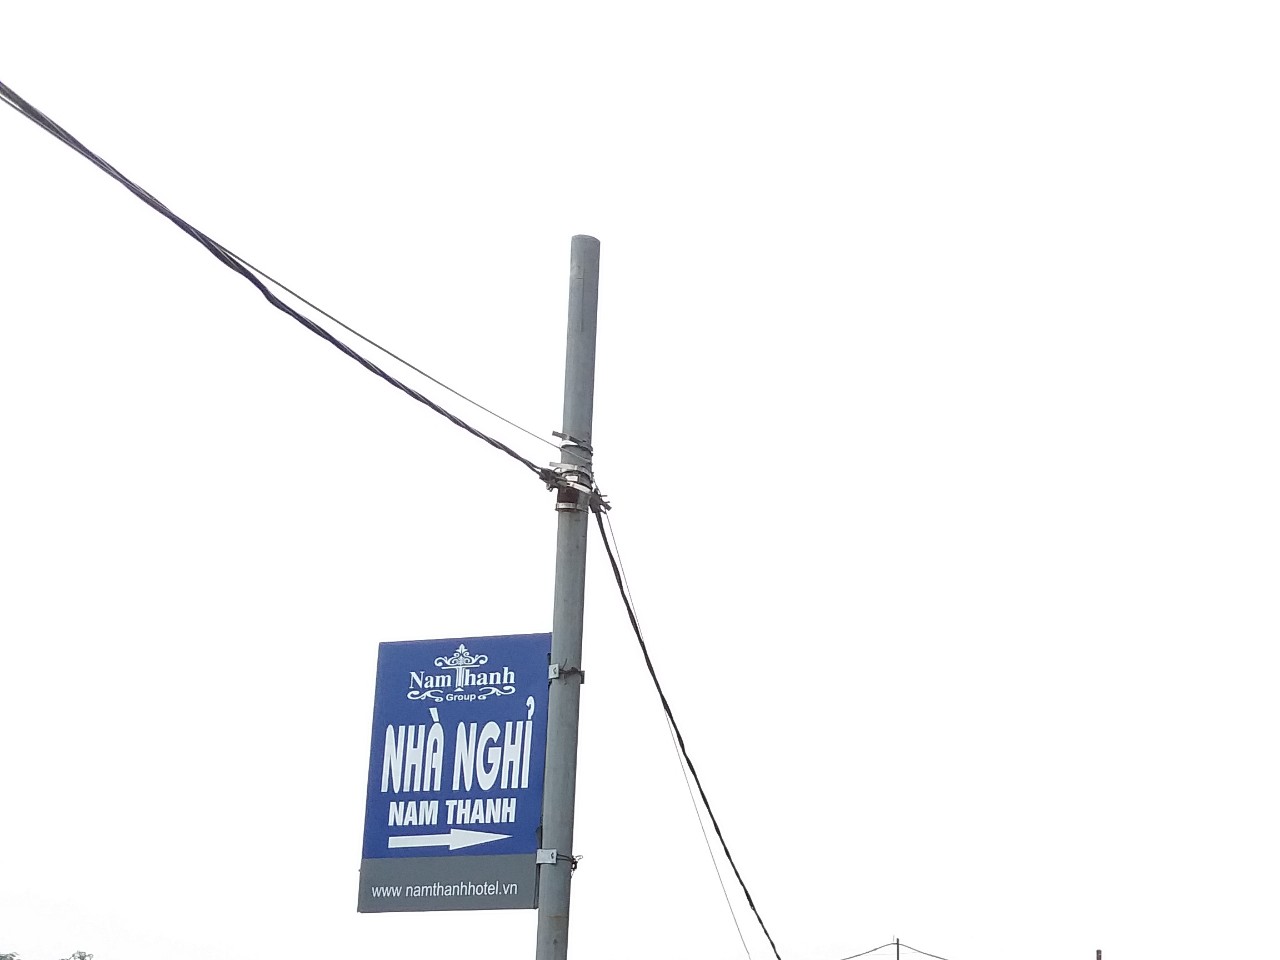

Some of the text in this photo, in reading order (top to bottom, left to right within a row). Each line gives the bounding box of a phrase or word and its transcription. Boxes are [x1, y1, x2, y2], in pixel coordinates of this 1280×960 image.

[409, 664, 515, 692] Nam Thanh
[446, 693, 476, 702] Group
[381, 696, 535, 793] NHÀ NGHỈ
[388, 798, 516, 826] NAM THANH
